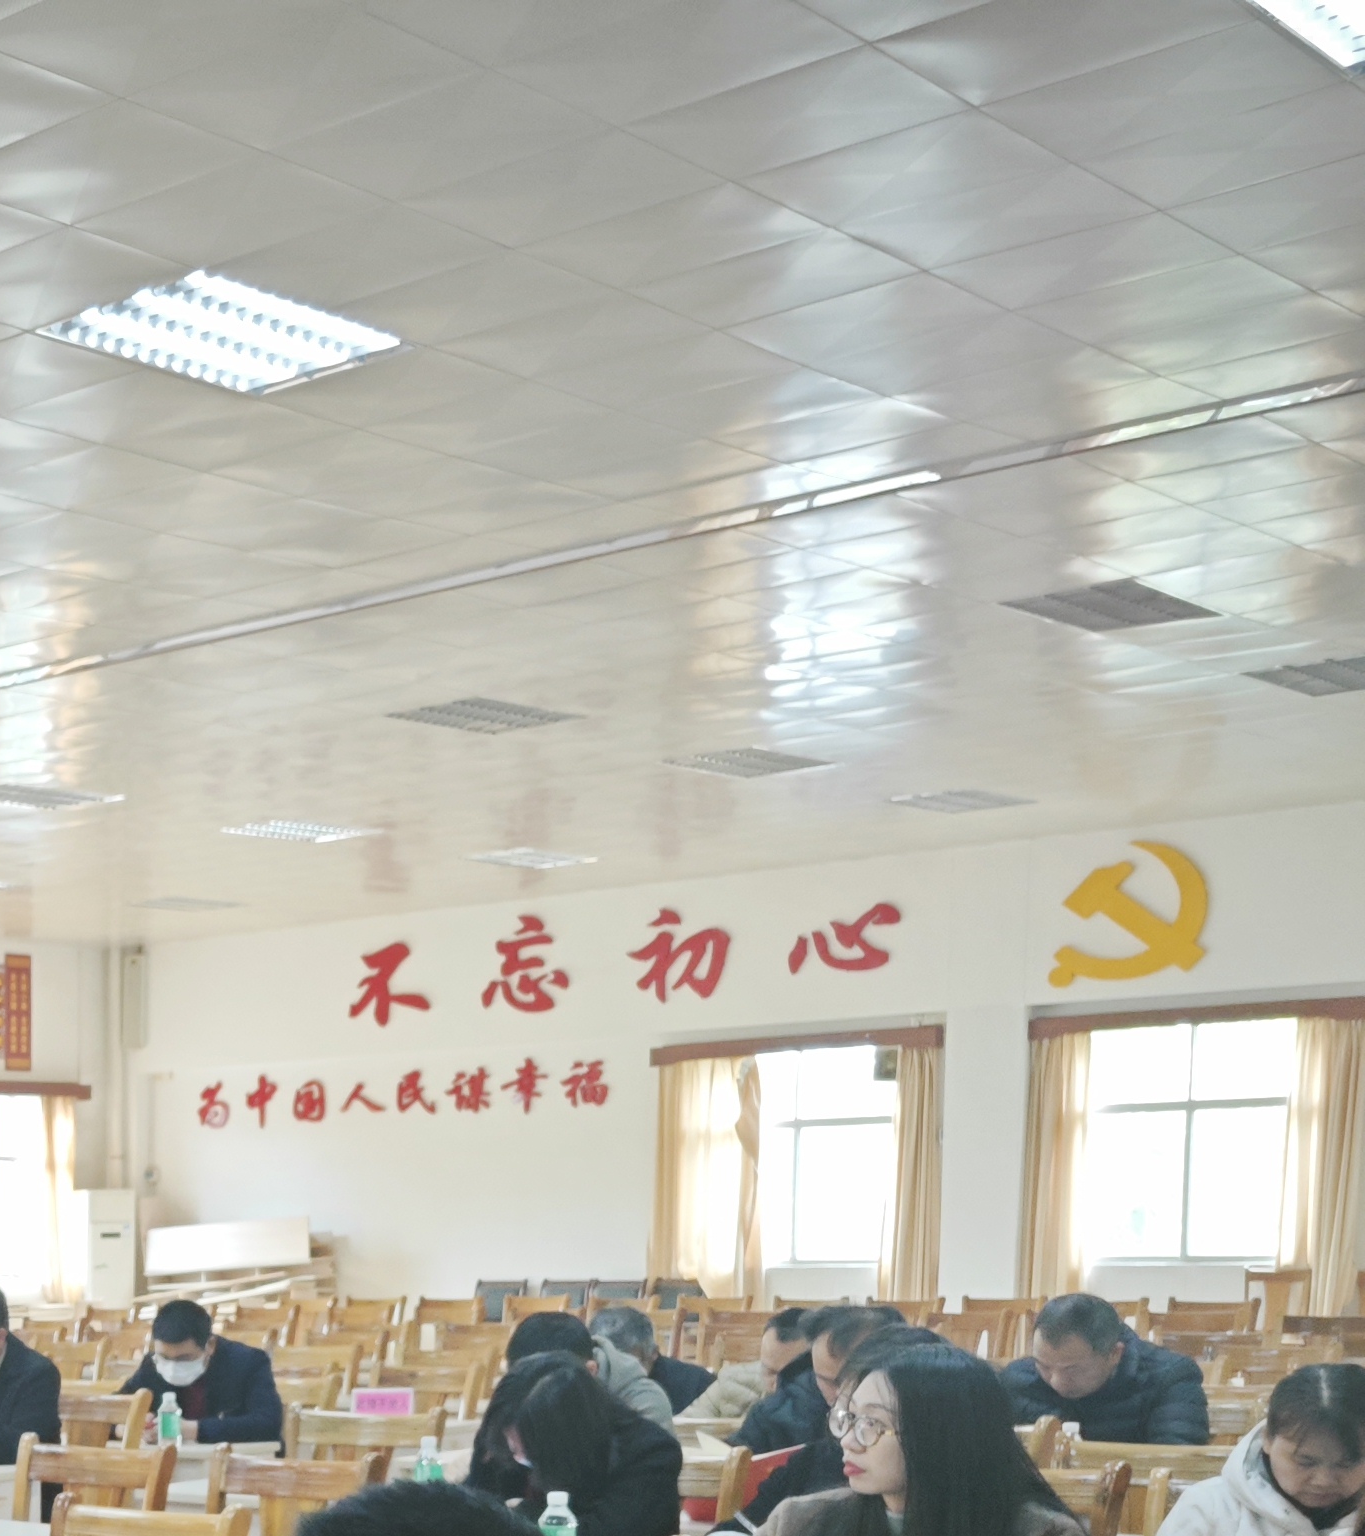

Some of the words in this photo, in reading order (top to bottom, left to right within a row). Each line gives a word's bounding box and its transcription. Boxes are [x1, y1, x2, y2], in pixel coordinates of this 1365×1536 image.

[349, 903, 901, 1027] 不忘初心
[197, 1058, 610, 1130] 为中国人民谋幸福
